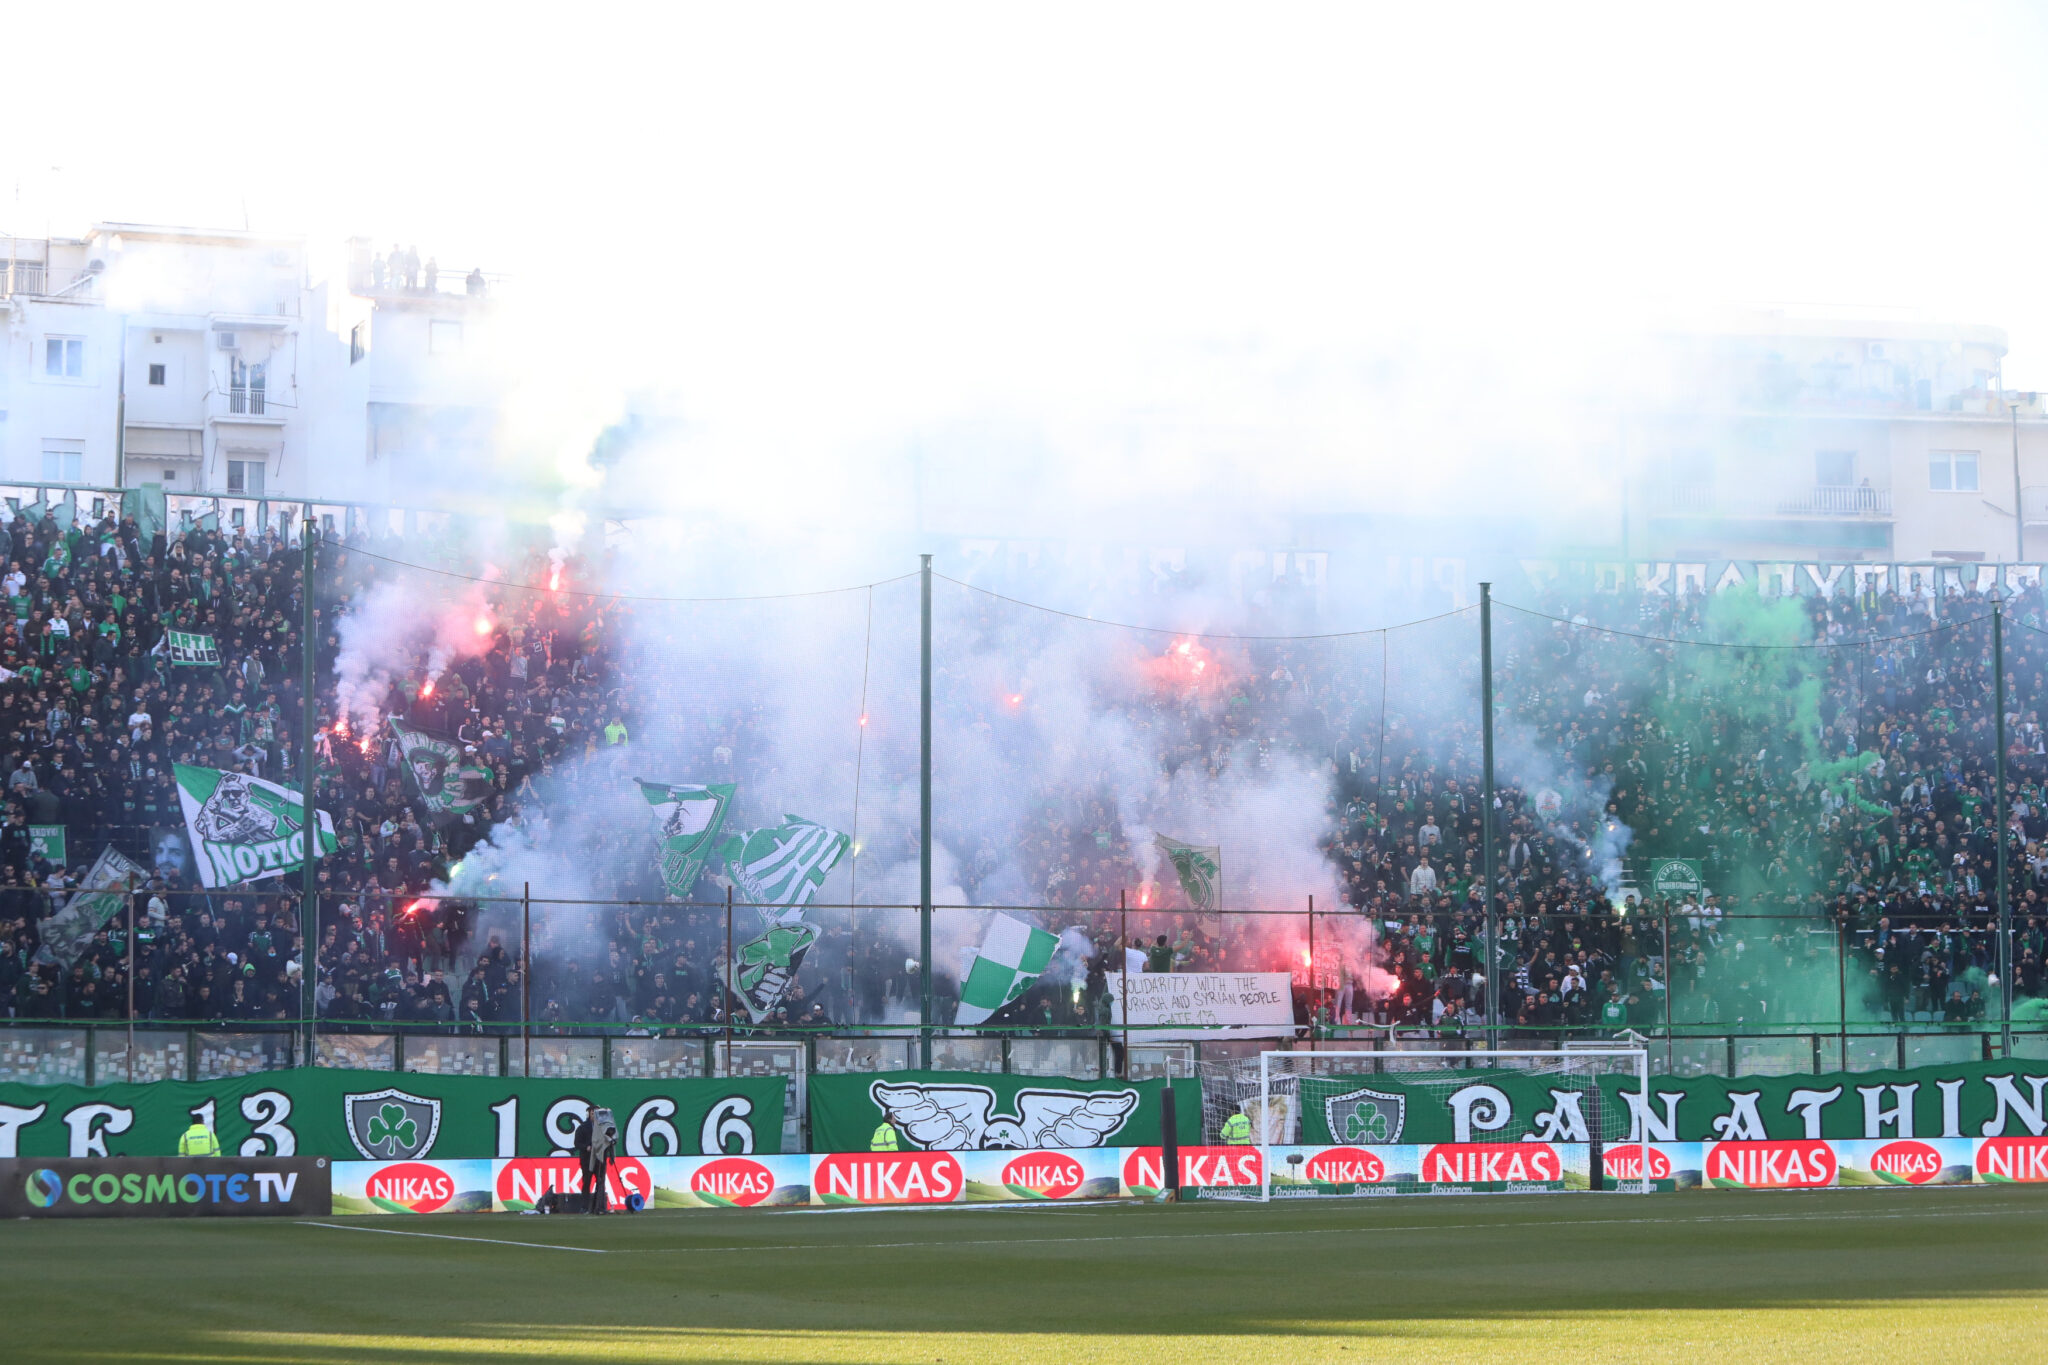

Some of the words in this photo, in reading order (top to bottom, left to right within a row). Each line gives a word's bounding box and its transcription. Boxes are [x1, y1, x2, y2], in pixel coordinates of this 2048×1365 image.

[170, 631, 216, 649] ARTA
[171, 646, 219, 662] CLUB
[1116, 976, 1189, 995] SOLIDARITY
[1195, 975, 1226, 992] WITH
[1234, 976, 1258, 992] THE
[1116, 995, 1168, 1012] TURKISH
[1172, 994, 1191, 1009] AND
[1193, 992, 1237, 1007] SYRIAN
[1240, 991, 1280, 1007] PEOPLE
[1158, 1012, 1193, 1025] GATE
[1197, 1010, 1218, 1025] 13
[1138, 1154, 1258, 1190] NKAS
[1313, 1160, 1379, 1182] NIKAS
[1435, 1152, 1550, 1182] NIKAS
[1719, 1149, 1827, 1184] NIKAS
[1876, 1153, 1938, 1174] NIKAS
[698, 1172, 769, 1194] NIKAS
[828, 1160, 952, 1200] NIKAS
[1009, 1164, 1079, 1188] NIKAS
[67, 1173, 250, 1204] COSMOTE
[253, 1172, 298, 1203] TV
[373, 1176, 449, 1200] NIKAS
[1196, 1186, 1240, 1198] Stoiximan
[1353, 1183, 1397, 1195] Stoiximan
[1506, 1181, 1548, 1193] Stoiximan
